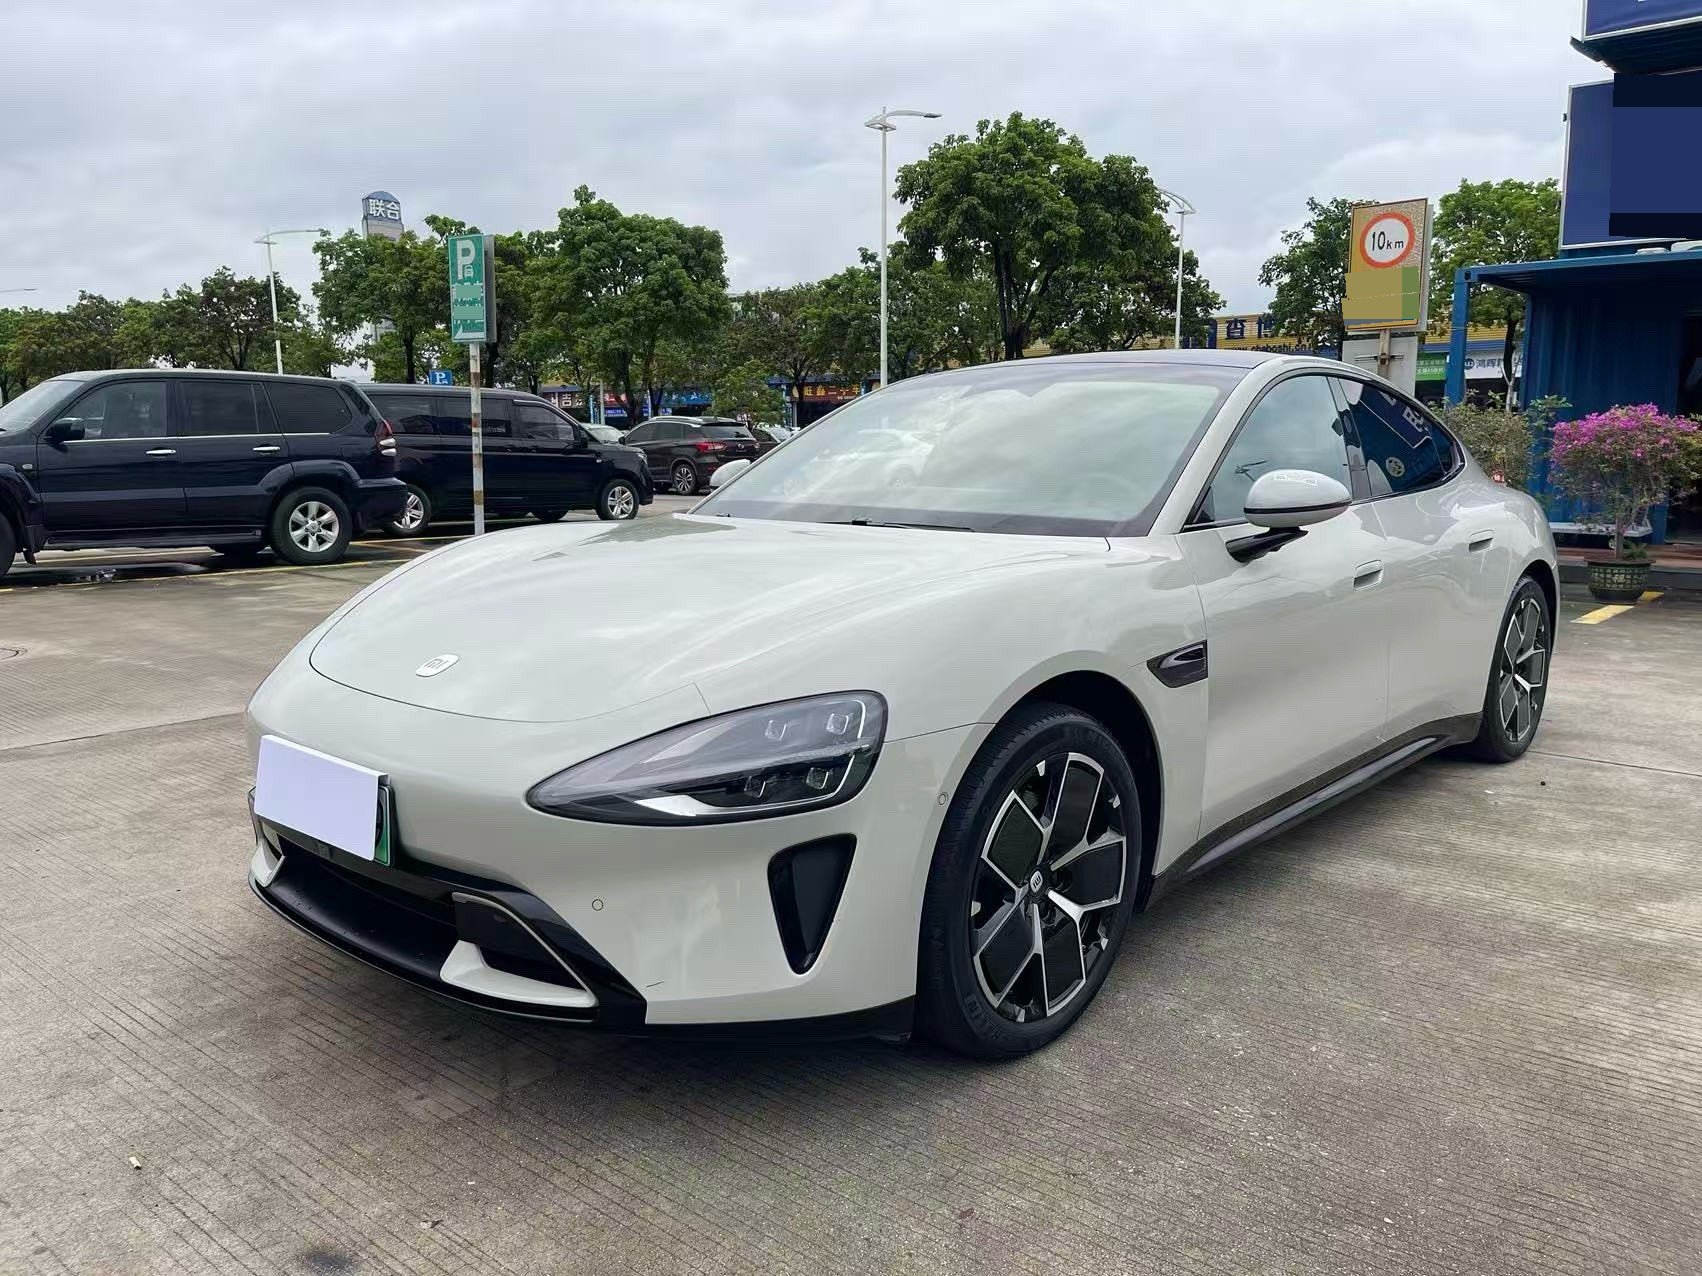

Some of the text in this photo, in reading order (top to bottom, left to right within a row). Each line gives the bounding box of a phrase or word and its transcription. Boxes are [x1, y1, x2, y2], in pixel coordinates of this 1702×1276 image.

[369, 199, 400, 220] 联合
[456, 239, 476, 280] P
[435, 372, 446, 385] P
